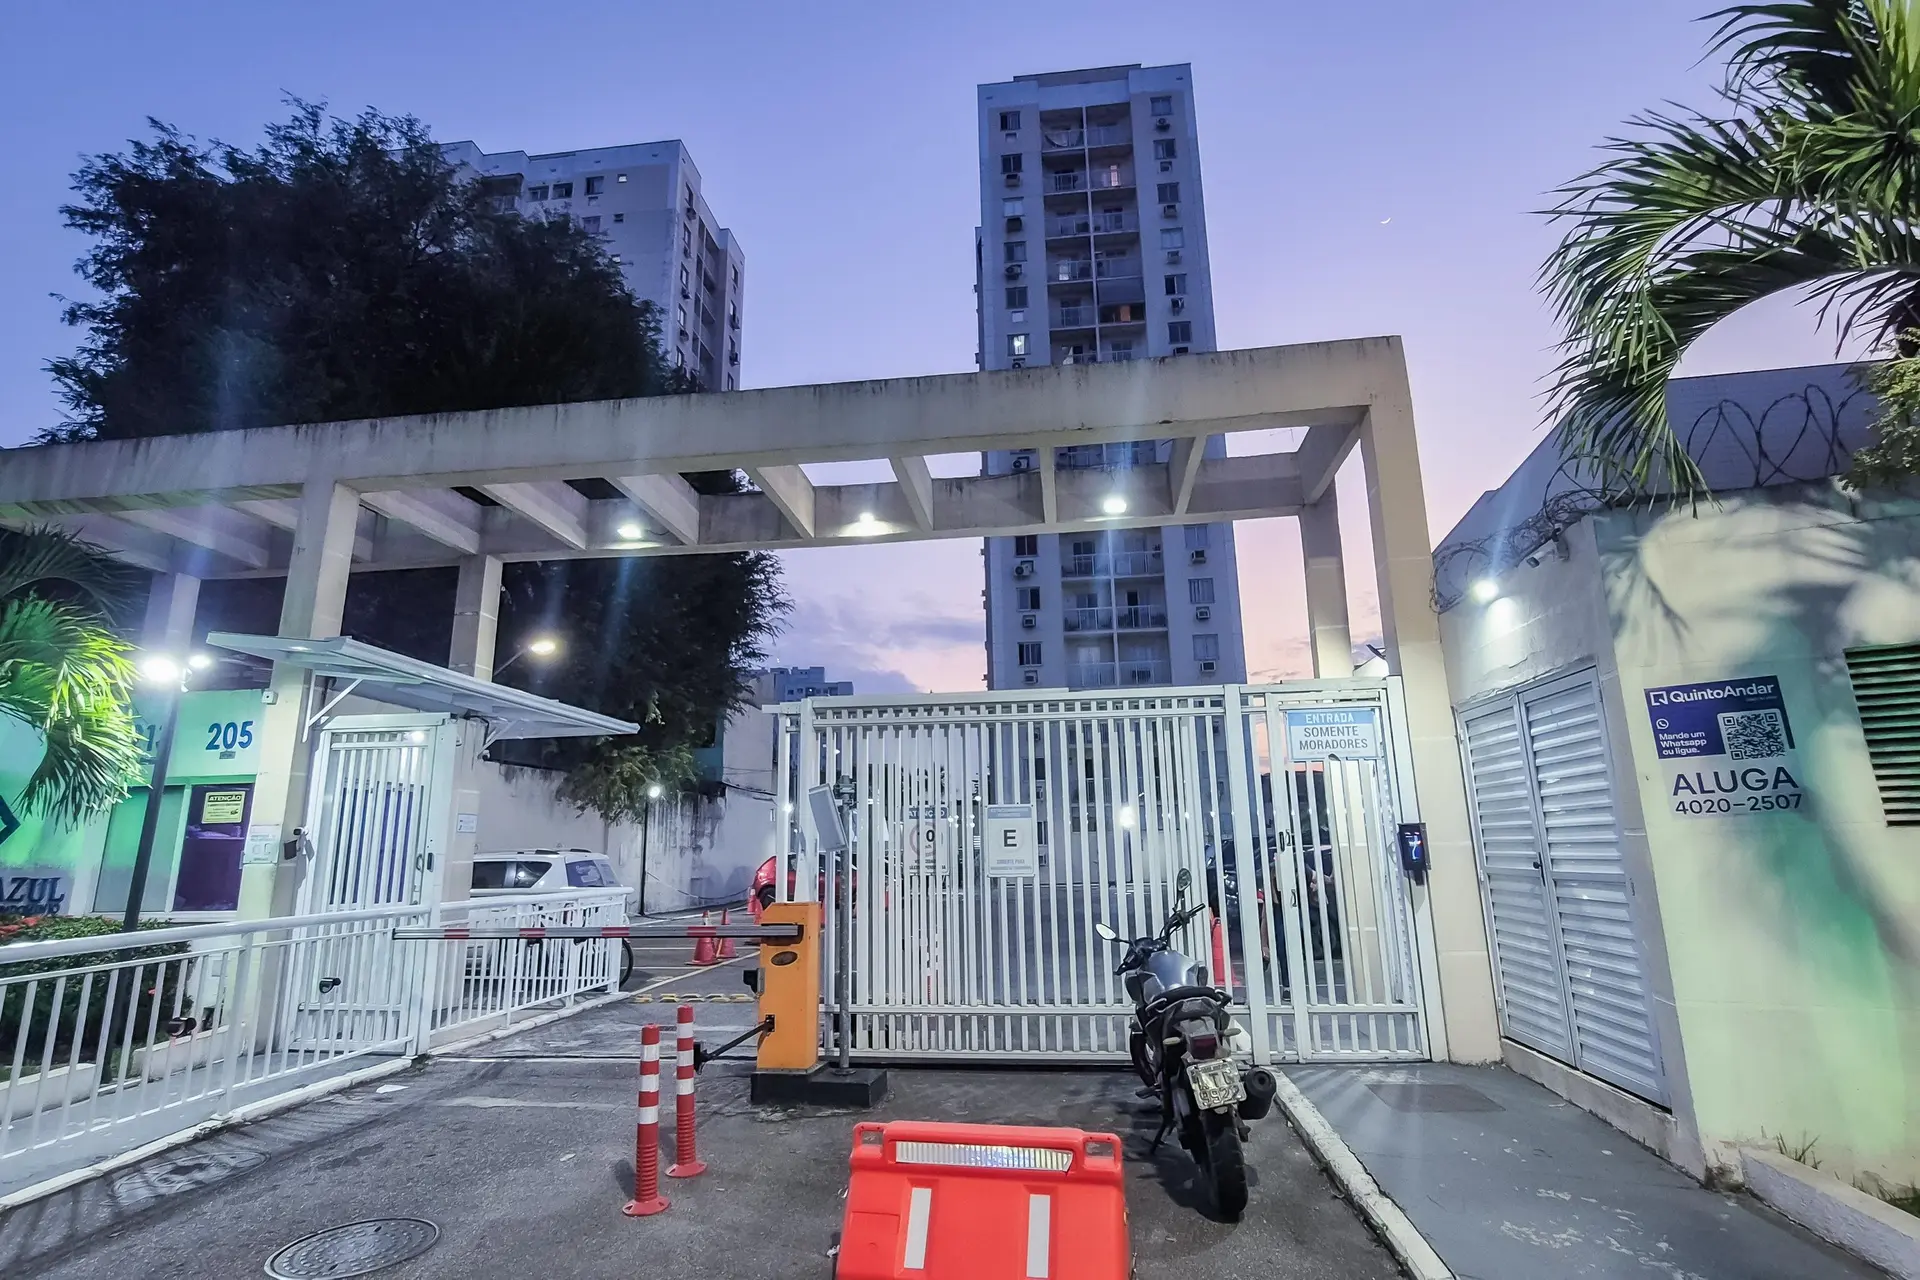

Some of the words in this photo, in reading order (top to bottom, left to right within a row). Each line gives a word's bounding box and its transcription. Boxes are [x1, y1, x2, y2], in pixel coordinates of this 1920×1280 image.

[1669, 683, 1775, 703] QuintoAndar
[1305, 712, 1354, 724] ENTRADA
[205, 720, 254, 750] 205
[1303, 726, 1359, 738] SOMENTE
[1659, 731, 1690, 740] Mande
[1690, 730, 1705, 738] um
[1299, 738, 1368, 751] MORADORES
[1660, 738, 1707, 749] Whatsapp
[1662, 748, 1674, 756] ou
[1675, 746, 1700, 756] ligue.
[1672, 766, 1799, 797] ALUGA
[208, 794, 242, 802] ATENÇÃO
[1675, 793, 1802, 815] 4020-2507
[1003, 829, 1018, 847] E
[0, 876, 65, 902] ZUL
